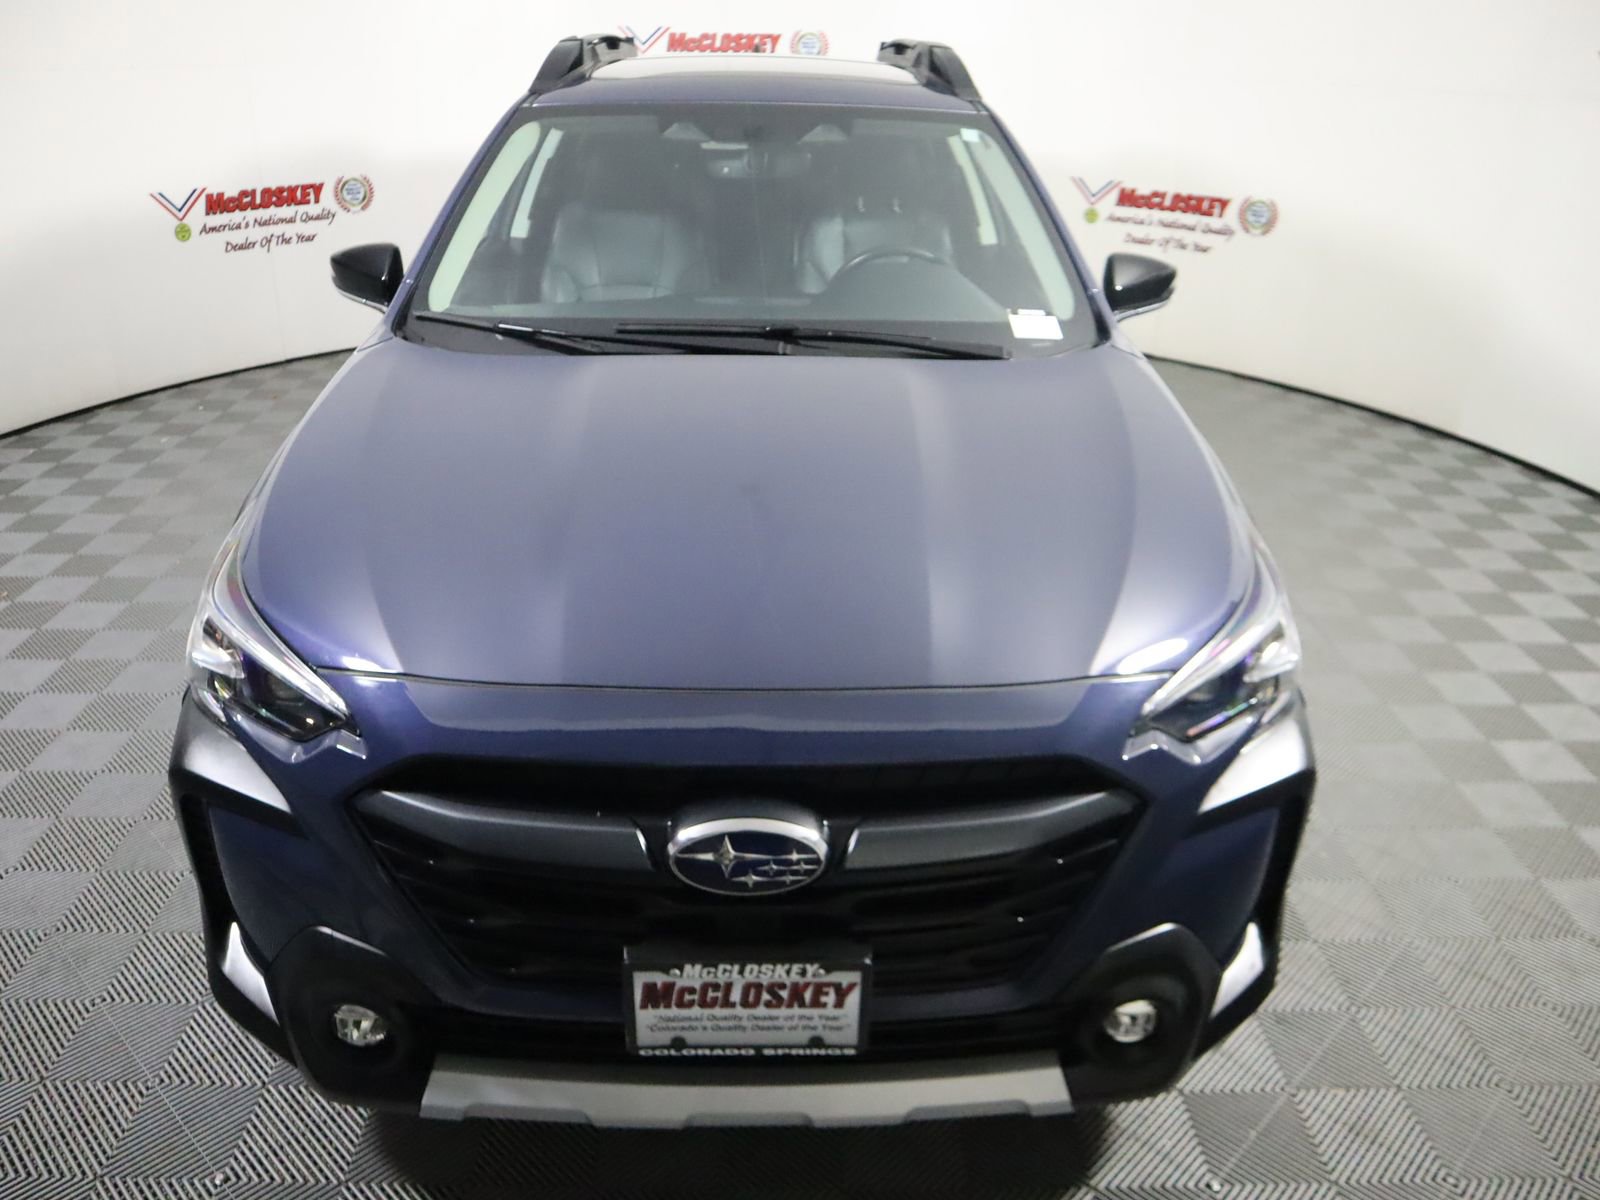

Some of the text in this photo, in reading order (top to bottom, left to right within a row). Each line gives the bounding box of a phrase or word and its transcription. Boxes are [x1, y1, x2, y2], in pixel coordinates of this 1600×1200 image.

[666, 31, 782, 54] McCLOSKEY
[204, 182, 325, 216] McCLOSKEY
[1116, 187, 1231, 218] McCLOSKEY
[199, 208, 336, 235] America's National Quality
[224, 231, 317, 254] Dealer Of The Year
[681, 963, 821, 979] McCLOSKEY
[639, 980, 858, 1010] McCLOSKEY
[706, 1013, 743, 1023] Quality
[710, 1023, 747, 1033] Quality
[638, 1047, 857, 1057] COLORADO SPRINGS
